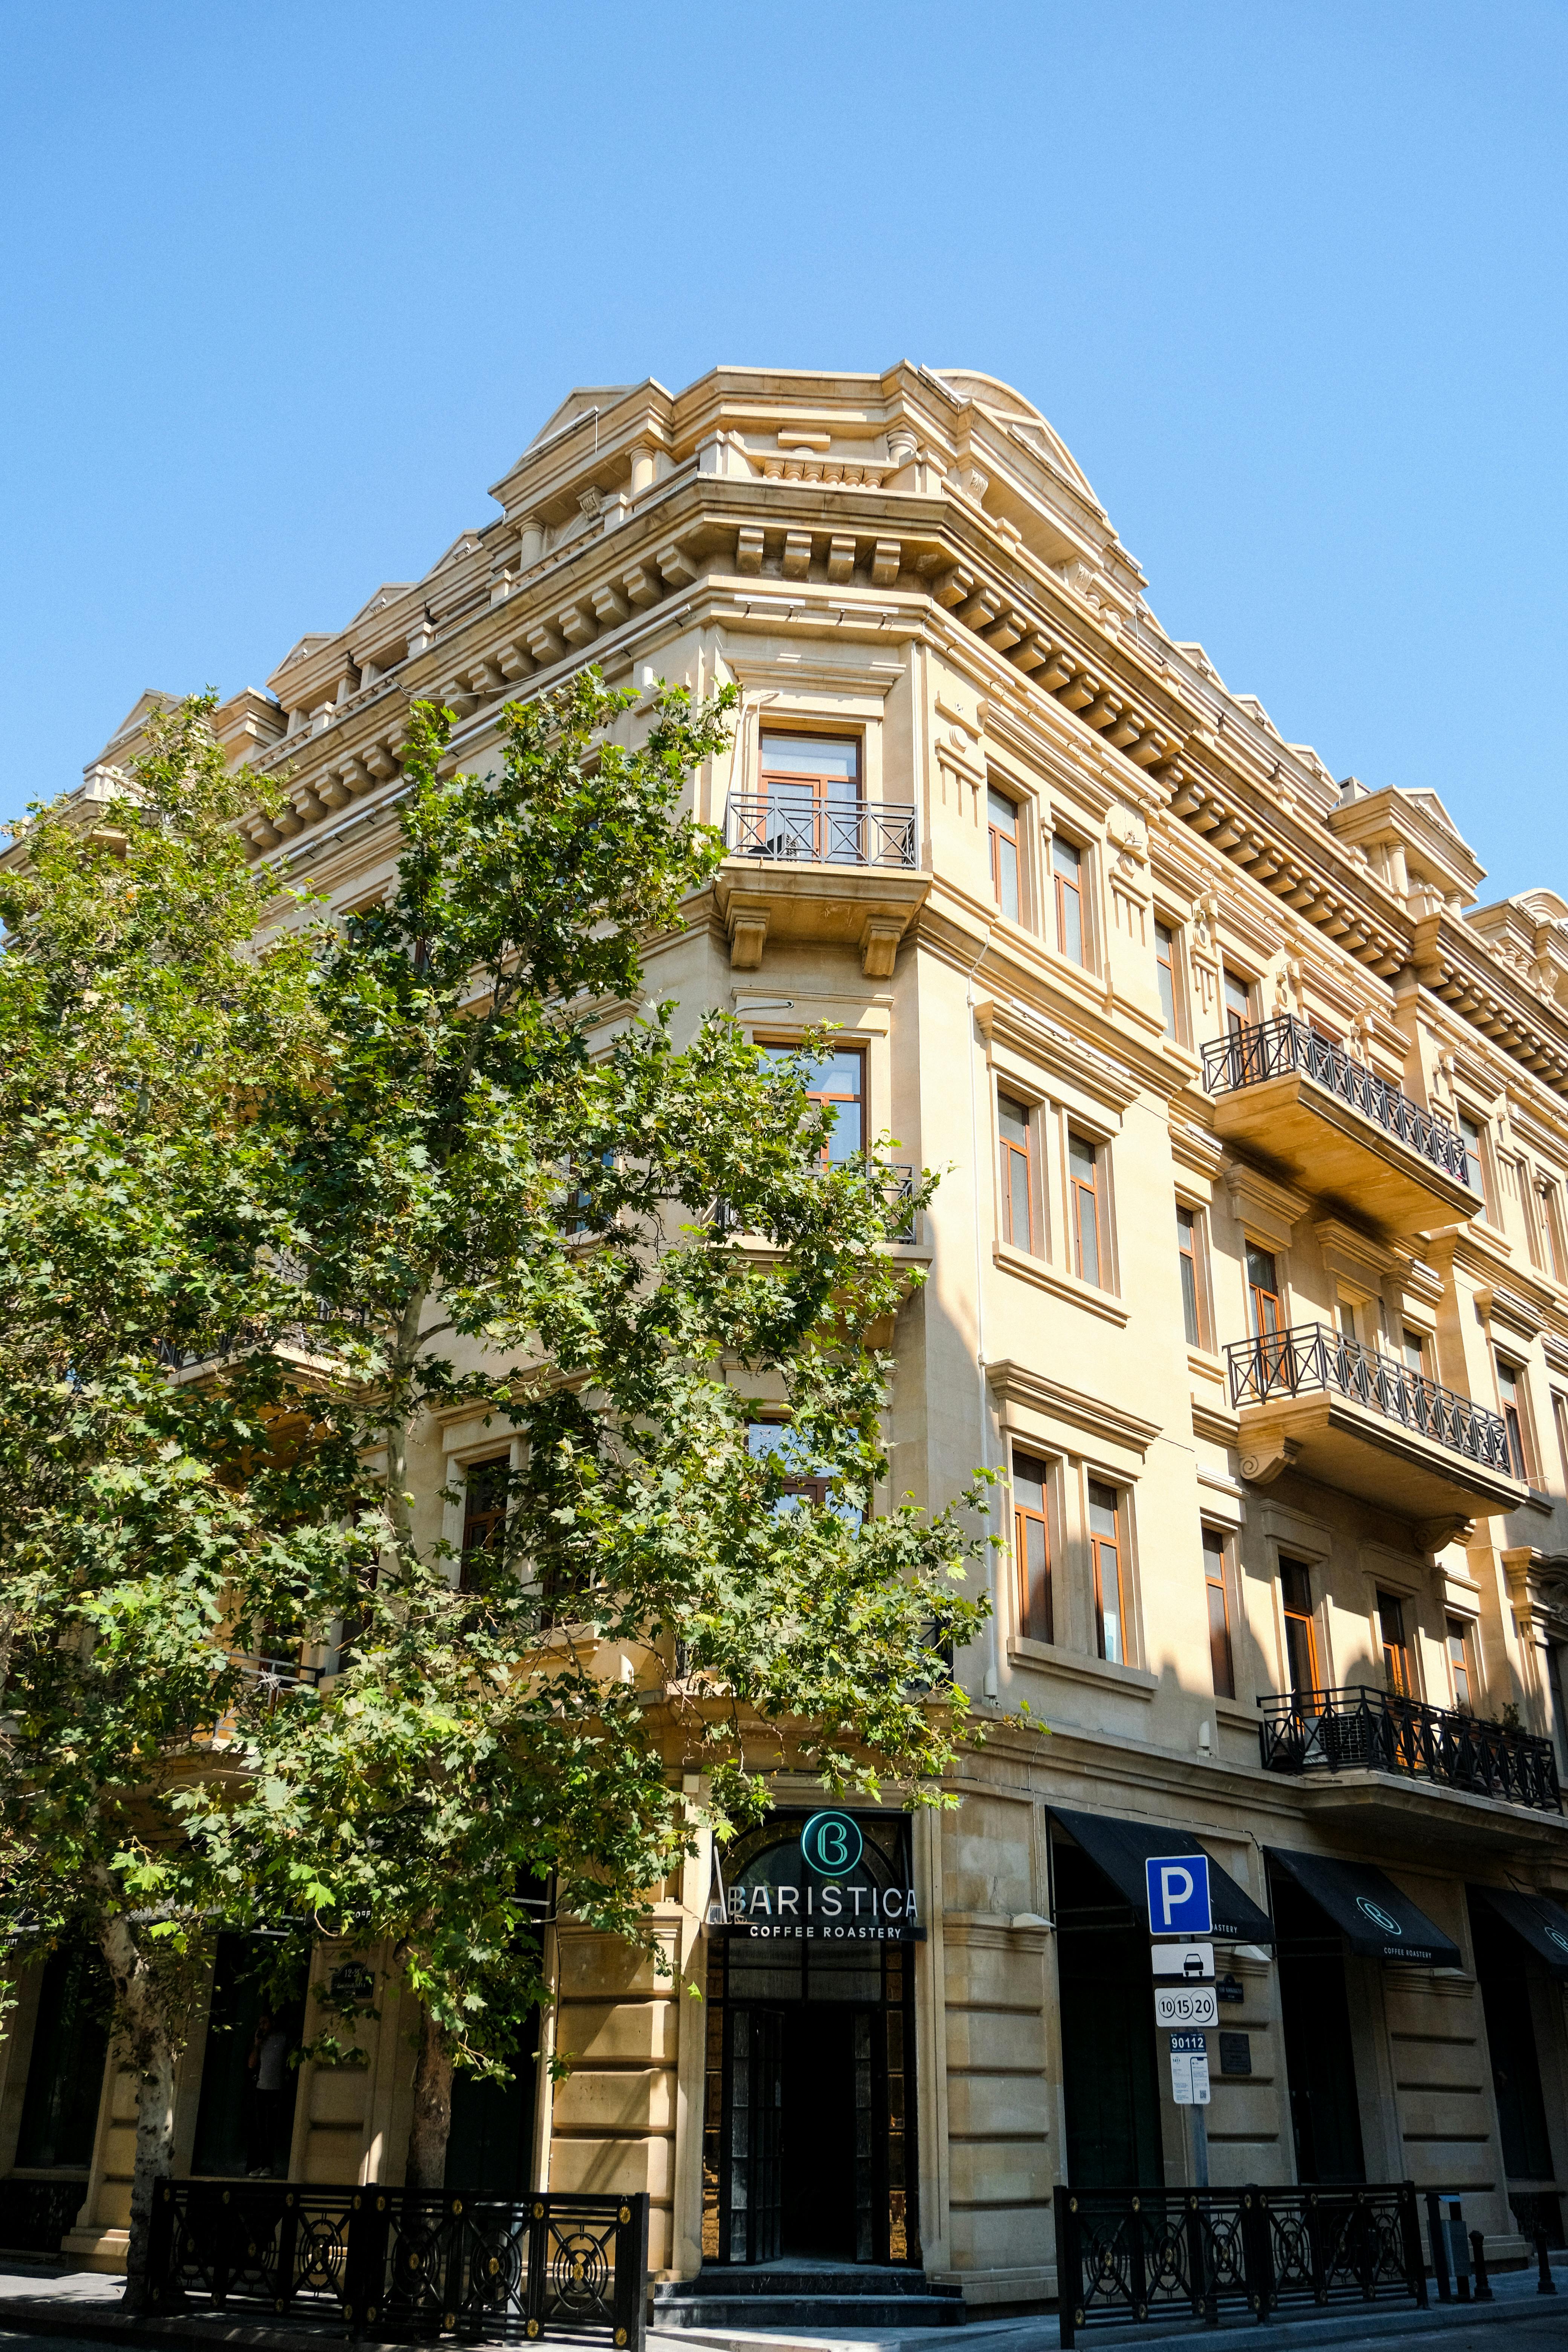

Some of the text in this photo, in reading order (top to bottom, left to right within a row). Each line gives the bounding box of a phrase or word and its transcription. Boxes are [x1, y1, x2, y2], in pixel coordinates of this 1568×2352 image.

[727, 1885, 918, 1918] BARISTICA
[1161, 1867, 1194, 1925] P
[750, 1926, 902, 1939] COFFEE ROASTERY
[1212, 1923, 1237, 1934] ASTERY
[1384, 1947, 1432, 1959] COFFEE ROASTERY
[1161, 1999, 1211, 2014] 10 15 20
[1171, 2037, 1204, 2048] 90112
